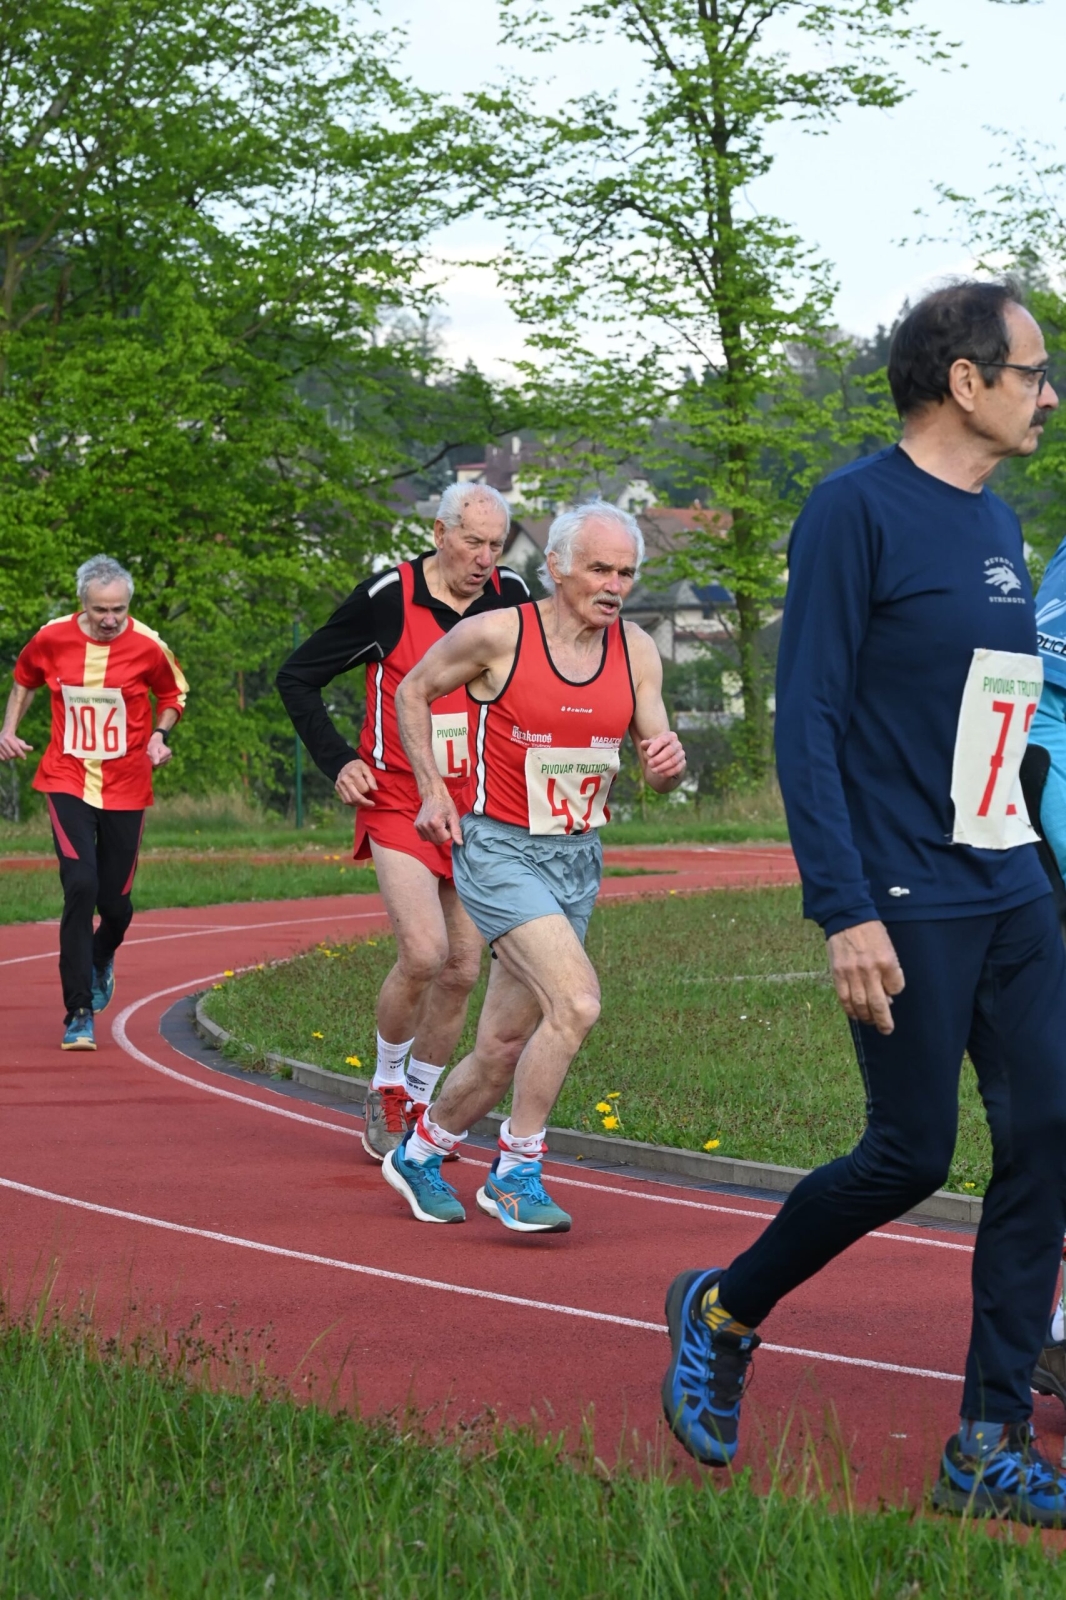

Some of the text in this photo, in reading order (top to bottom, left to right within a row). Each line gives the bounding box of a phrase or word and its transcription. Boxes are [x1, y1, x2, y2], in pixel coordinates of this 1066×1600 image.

[984, 557, 1014, 569] NEVADA
[989, 597, 1026, 605] STRENGTH
[69, 706, 119, 752] 106
[437, 727, 467, 738] PIVOVAR
[541, 763, 610, 774] PIVOVAR TRUTNOV
[547, 774, 601, 835] 42
